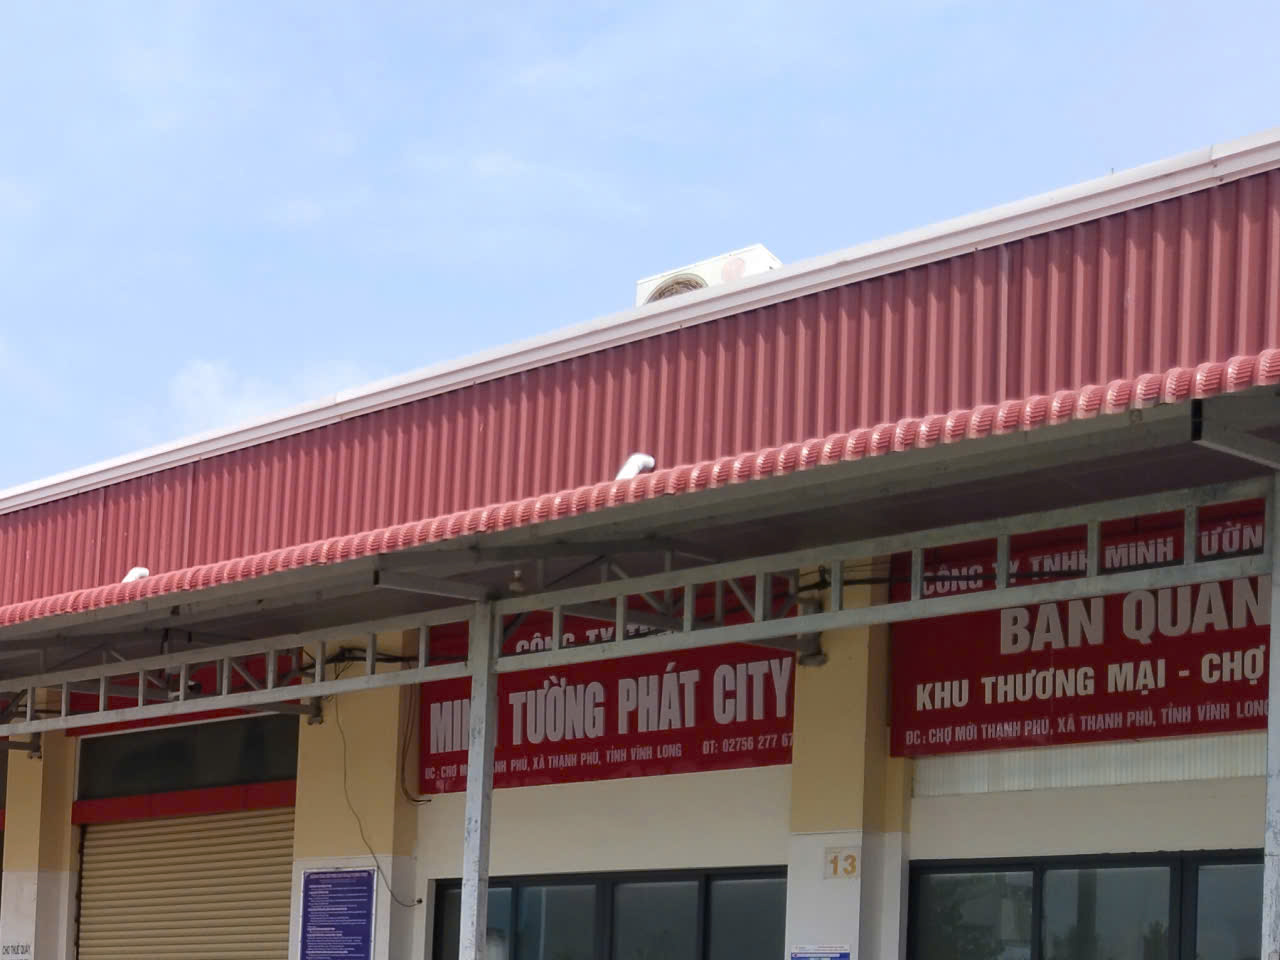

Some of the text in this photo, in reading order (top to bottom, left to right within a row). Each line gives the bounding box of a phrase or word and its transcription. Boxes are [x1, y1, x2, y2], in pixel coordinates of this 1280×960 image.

[1105, 536, 1174, 569] MINH
[916, 679, 969, 711] KHU
[981, 666, 1095, 704] THƯƠNG
[1107, 658, 1166, 695] MẠI
[1200, 645, 1266, 685] CHỢ
[429, 656, 793, 755] MIN TƯỜNG PHÁT CITY
[757, 734, 778, 750] 277
[829, 854, 857, 876] 13
